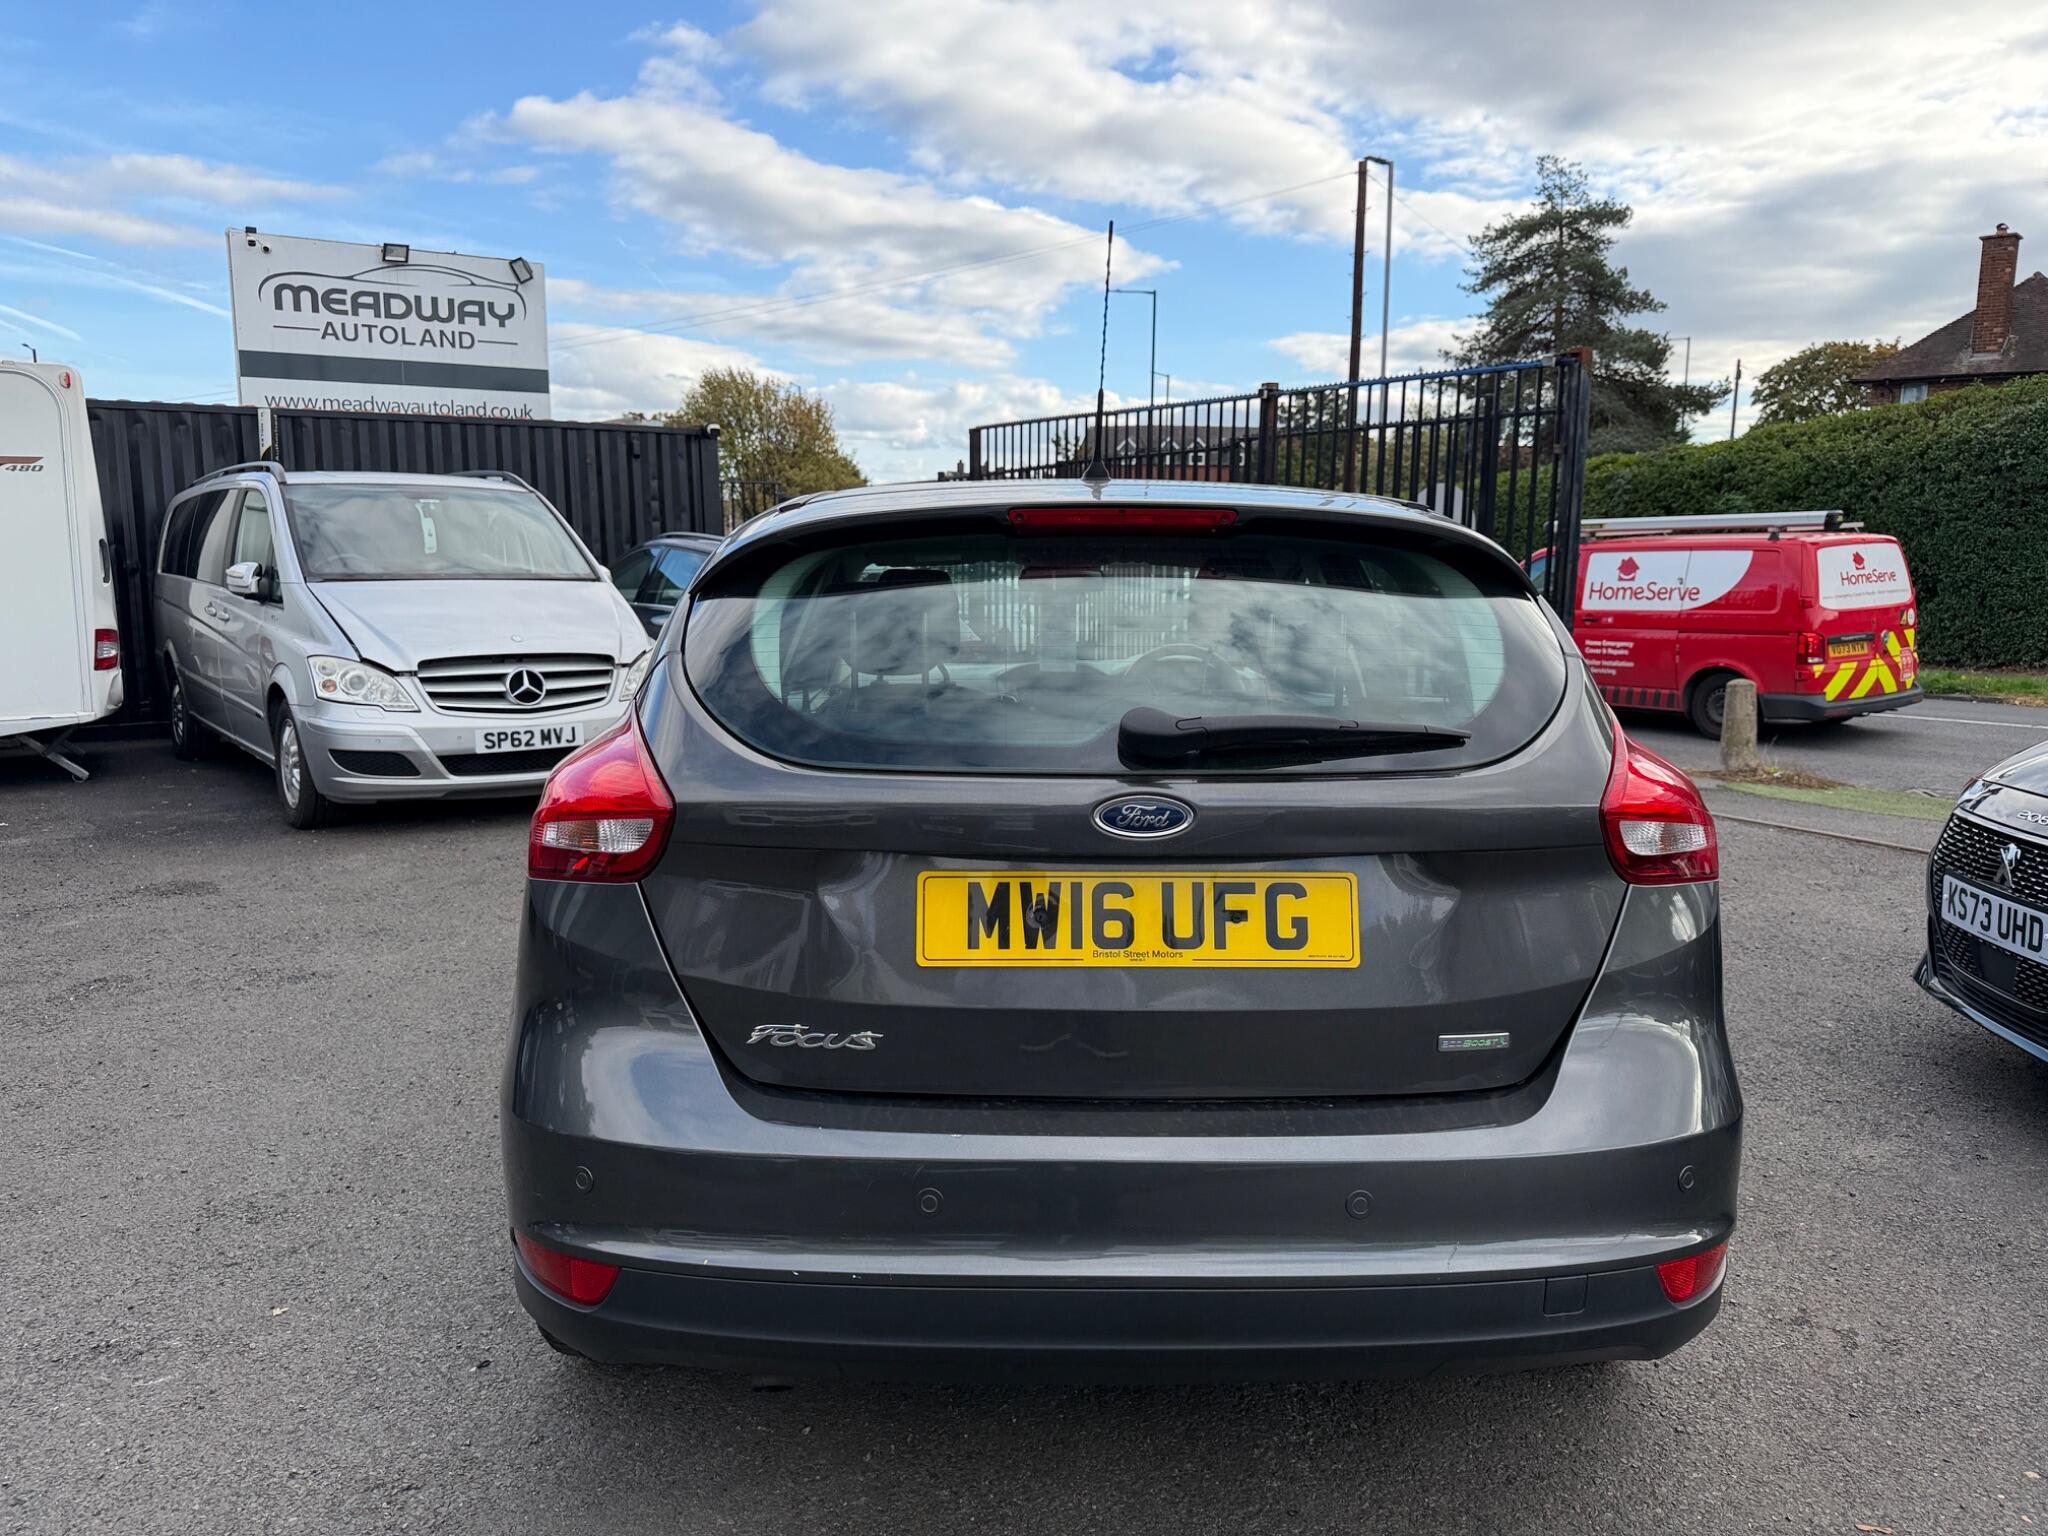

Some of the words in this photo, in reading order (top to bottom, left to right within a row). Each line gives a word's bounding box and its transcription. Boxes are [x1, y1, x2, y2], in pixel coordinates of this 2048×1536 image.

[273, 283, 515, 328] MEADWAY
[320, 321, 475, 349] AUTOLAND
[264, 395, 533, 420] www.meadwayautoland.co.uk
[1840, 568, 1897, 586] HomeServe
[1589, 581, 1700, 601] HomeServe
[484, 730, 535, 749] SP62
[540, 726, 576, 746] MVJ
[1116, 804, 1170, 828] Ford
[967, 881, 1134, 950] MW16
[1161, 881, 1309, 950] UFG
[1947, 880, 1993, 933] KS73
[1997, 902, 2044, 953] UHD
[1092, 949, 1120, 958] Bristol
[1123, 949, 1149, 958] Street
[1152, 949, 1183, 958] Motors
